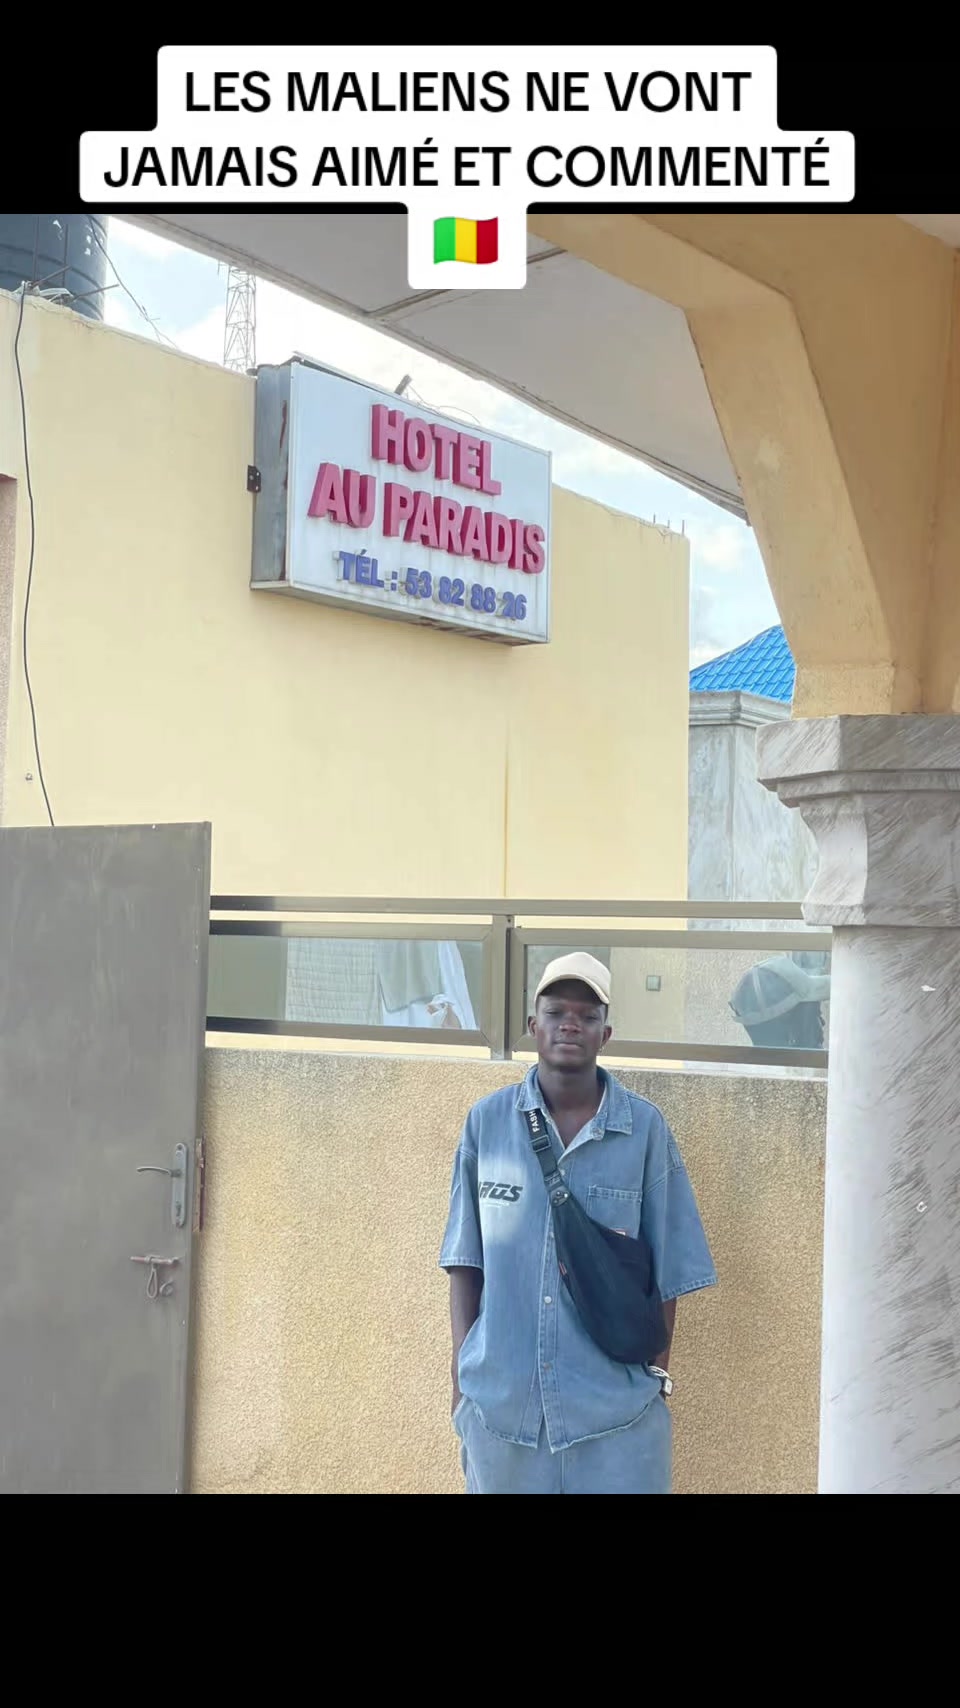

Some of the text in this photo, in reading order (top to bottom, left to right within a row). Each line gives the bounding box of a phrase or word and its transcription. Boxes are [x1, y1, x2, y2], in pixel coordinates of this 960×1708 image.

[371, 403, 502, 496] HOTEL
[307, 462, 546, 574] AU PARADIS
[404, 567, 432, 599] 53
[438, 576, 465, 607] 82
[470, 583, 497, 614] 88
[502, 591, 527, 621] 26
